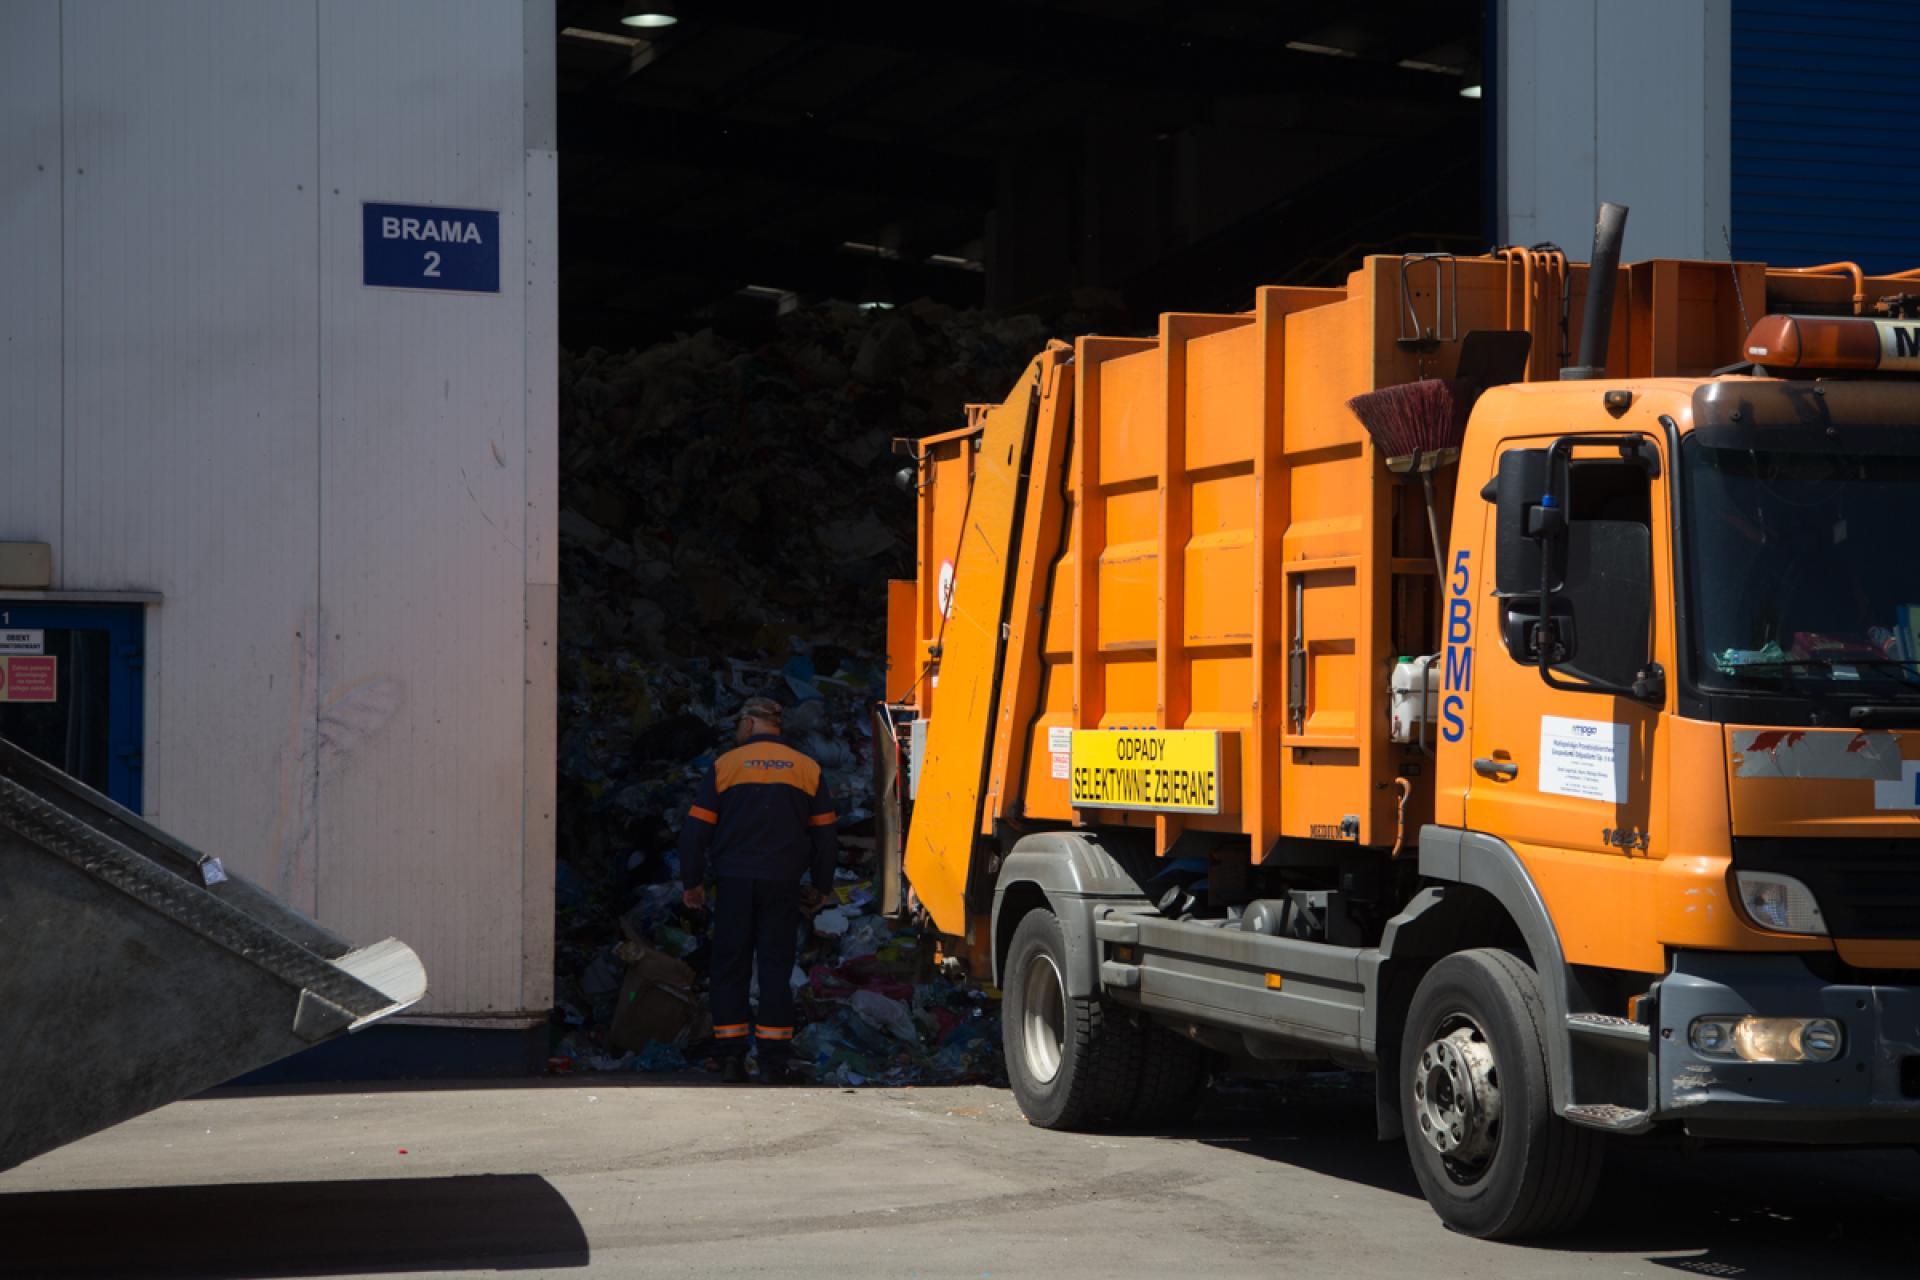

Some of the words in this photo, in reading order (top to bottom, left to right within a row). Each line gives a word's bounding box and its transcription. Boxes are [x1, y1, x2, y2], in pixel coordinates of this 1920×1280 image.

[382, 216, 482, 244] BRAMA
[423, 250, 441, 278] 2
[1, 611, 9, 625] 1
[1117, 738, 1166, 760] ODPADY
[1074, 767, 1151, 802] SELEKTYWNIE
[1155, 769, 1214, 806] ZBIERANE
